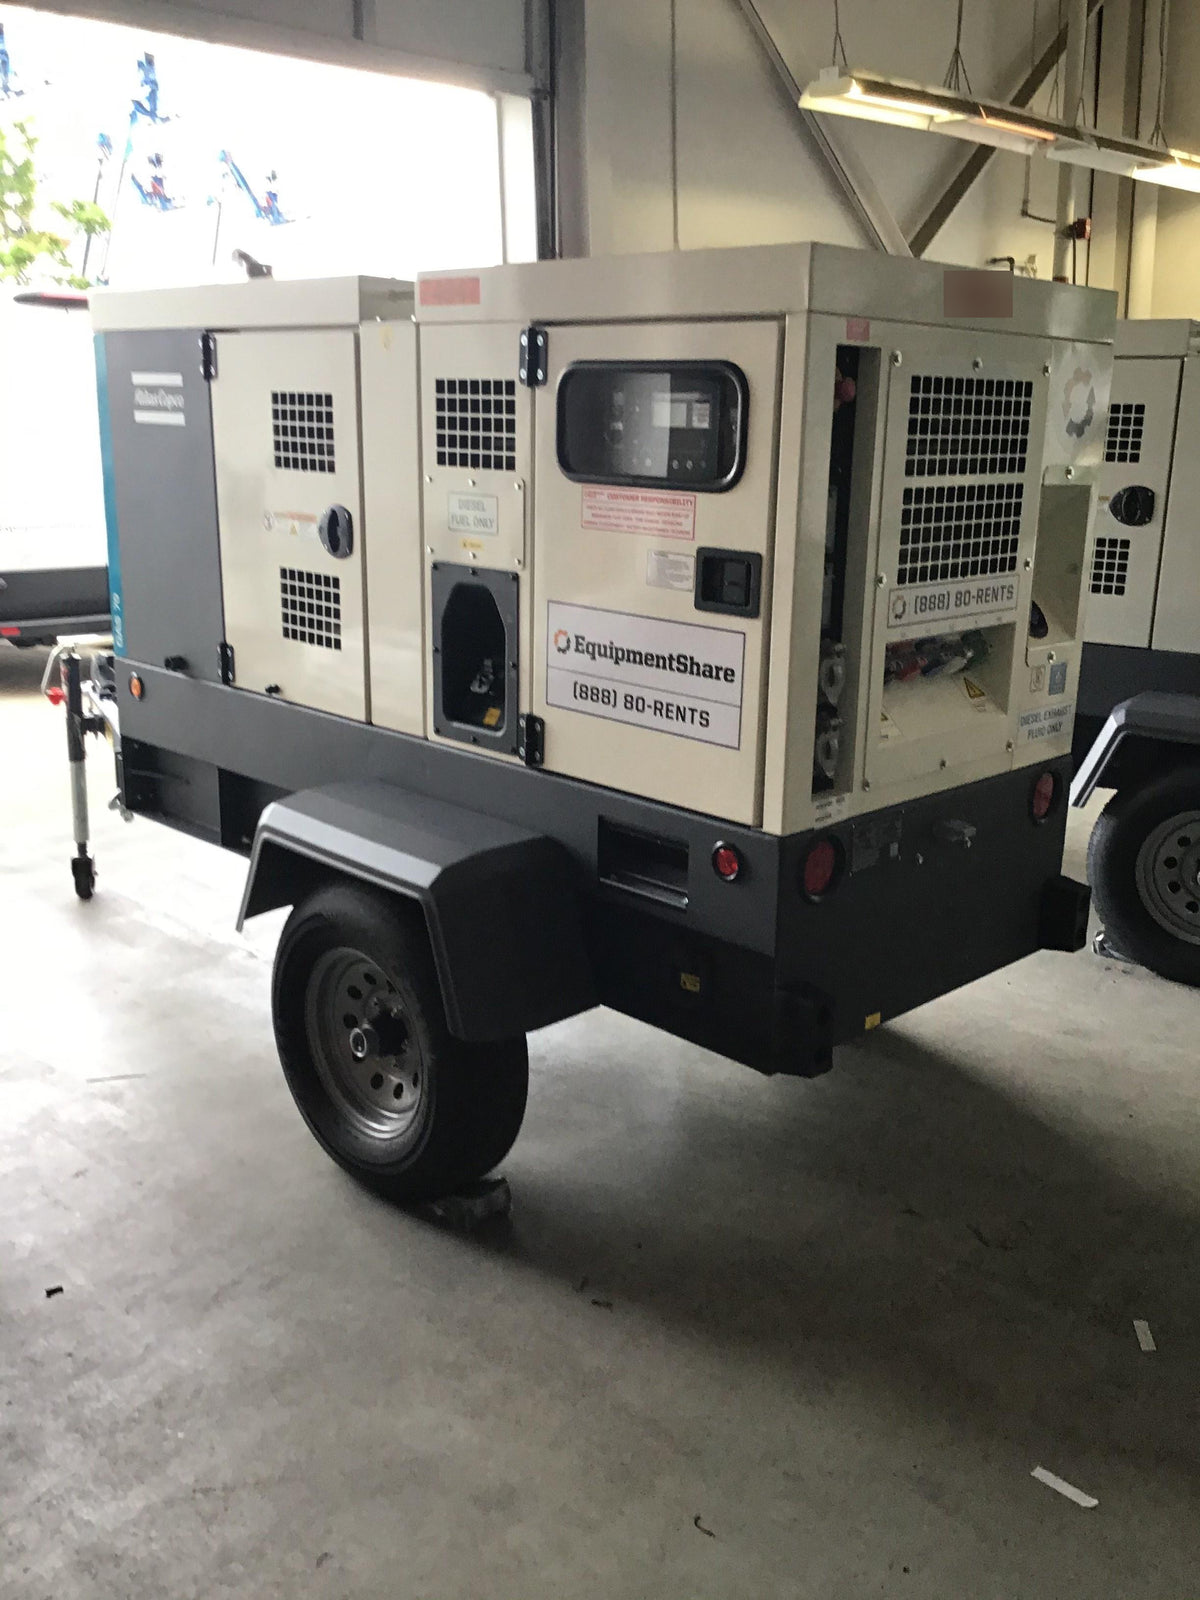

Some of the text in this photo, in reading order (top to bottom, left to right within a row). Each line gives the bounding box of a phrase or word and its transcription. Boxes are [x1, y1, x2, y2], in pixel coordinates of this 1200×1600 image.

[914, 584, 1014, 615] (888) 80-RENTS
[573, 634, 735, 684] EquipmentShare
[573, 680, 711, 728] (888) 80-RENTS
